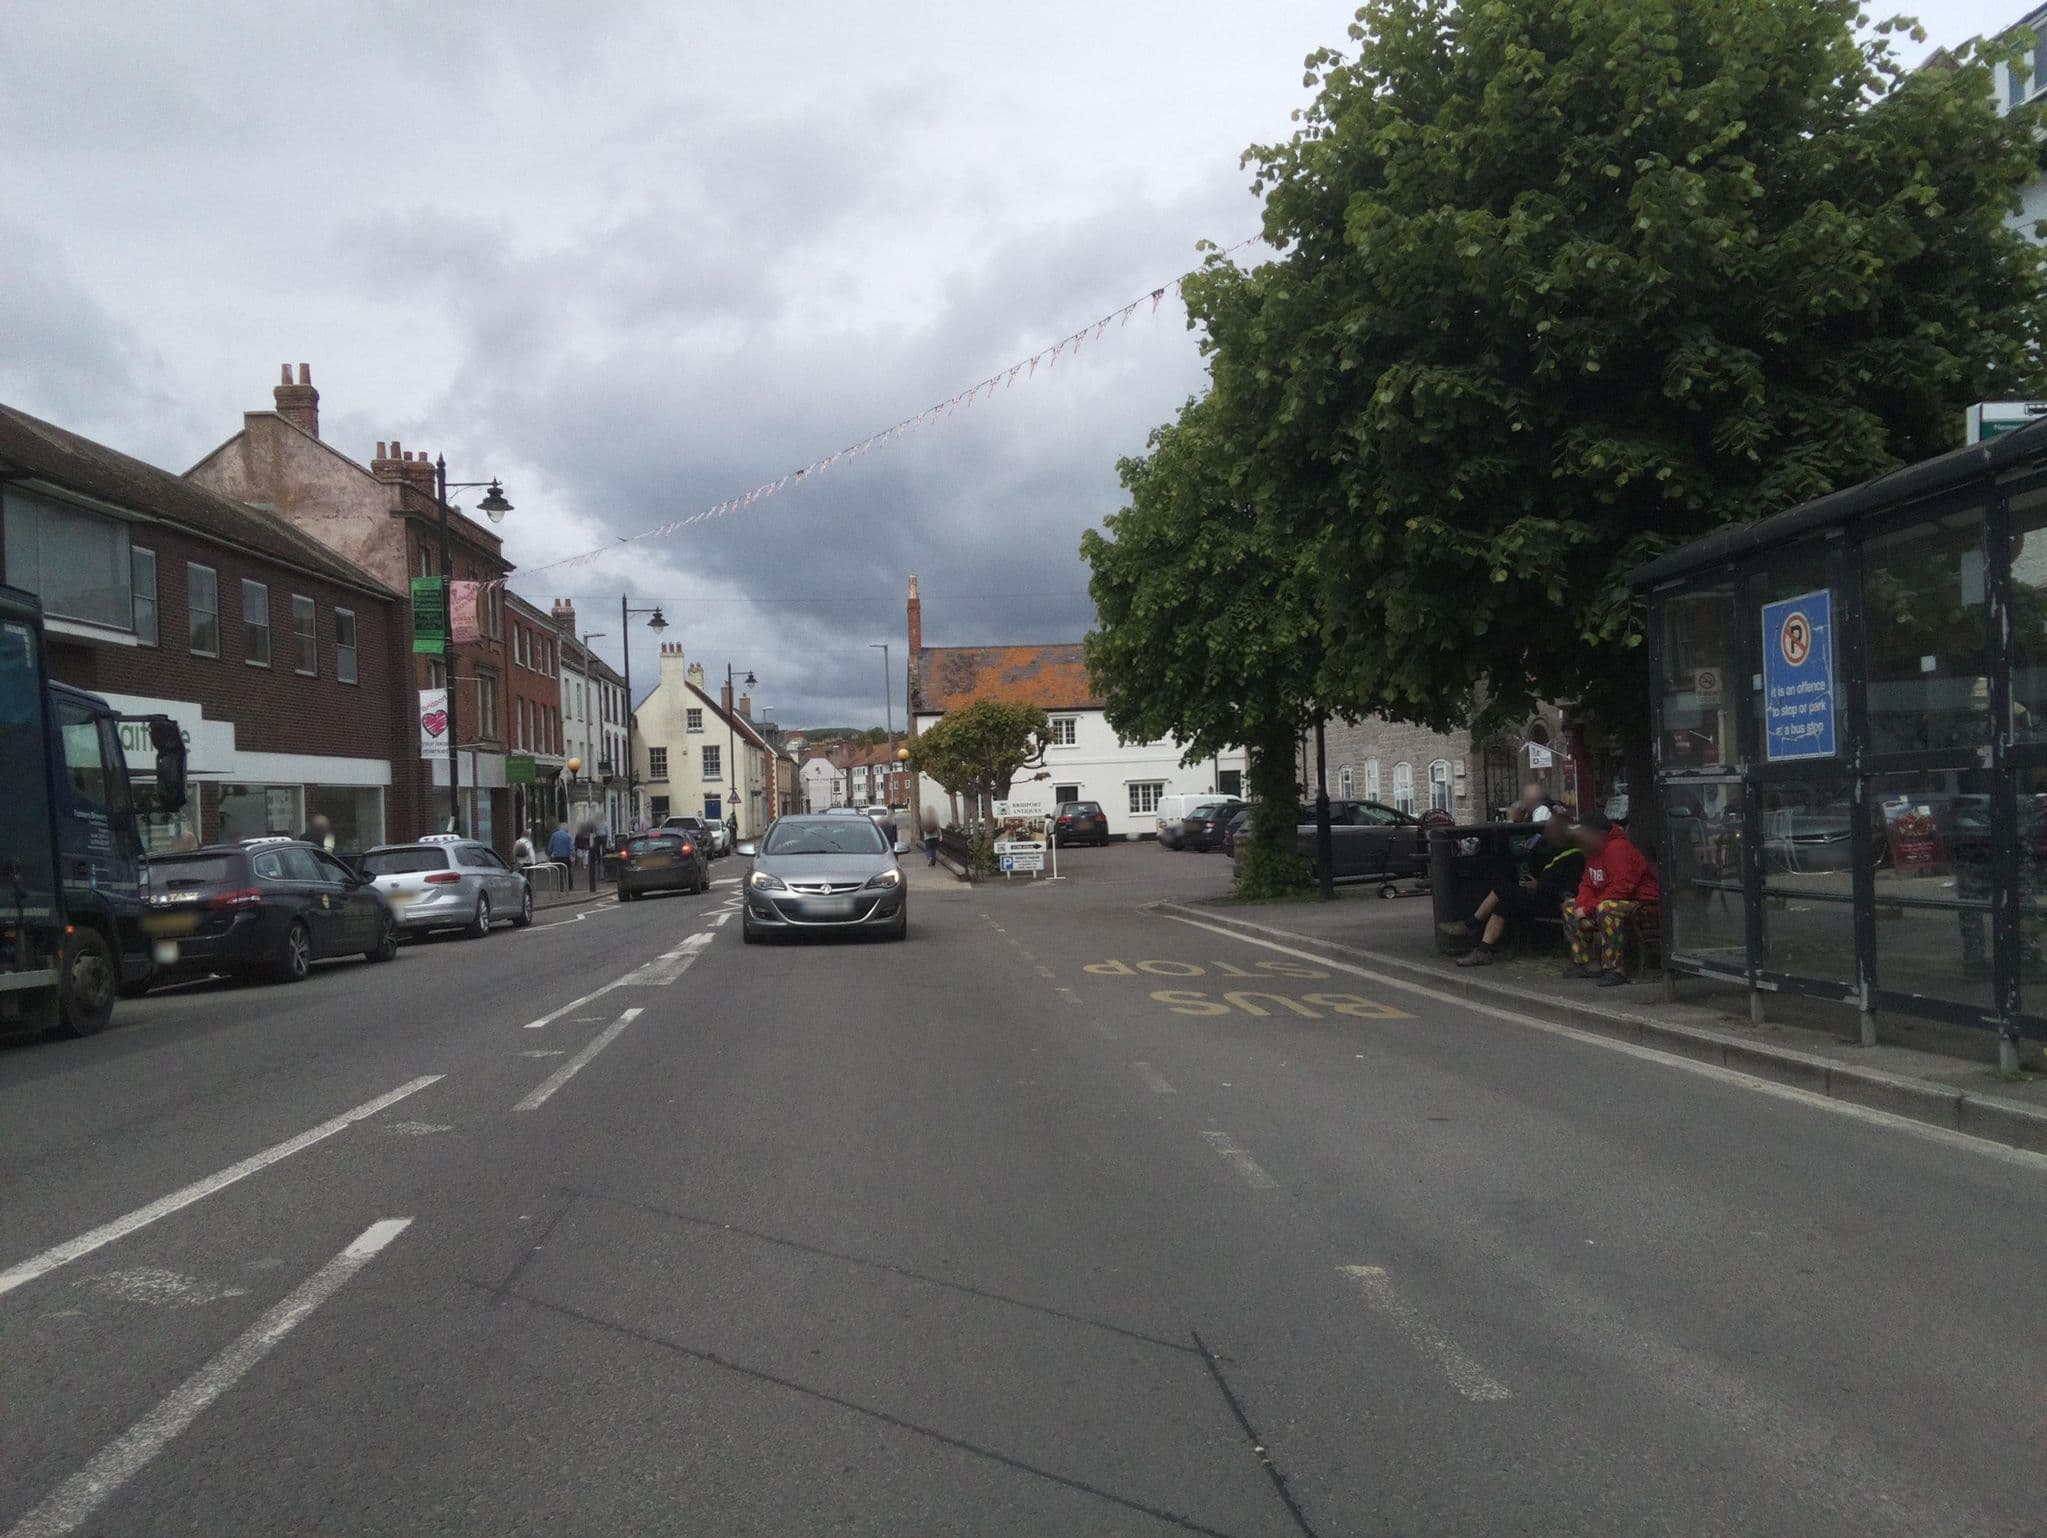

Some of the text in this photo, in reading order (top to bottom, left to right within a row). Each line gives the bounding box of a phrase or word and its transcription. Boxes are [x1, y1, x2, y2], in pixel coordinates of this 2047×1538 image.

[1778, 686, 1785, 697] is
[1786, 685, 1796, 696] an
[1797, 680, 1826, 695] offence
[1772, 701, 1827, 719] to stop or park
[1791, 721, 1806, 735] bus
[1807, 720, 1825, 736] stop
[1083, 959, 1331, 979] STOP
[1150, 990, 1420, 1019] BUS
